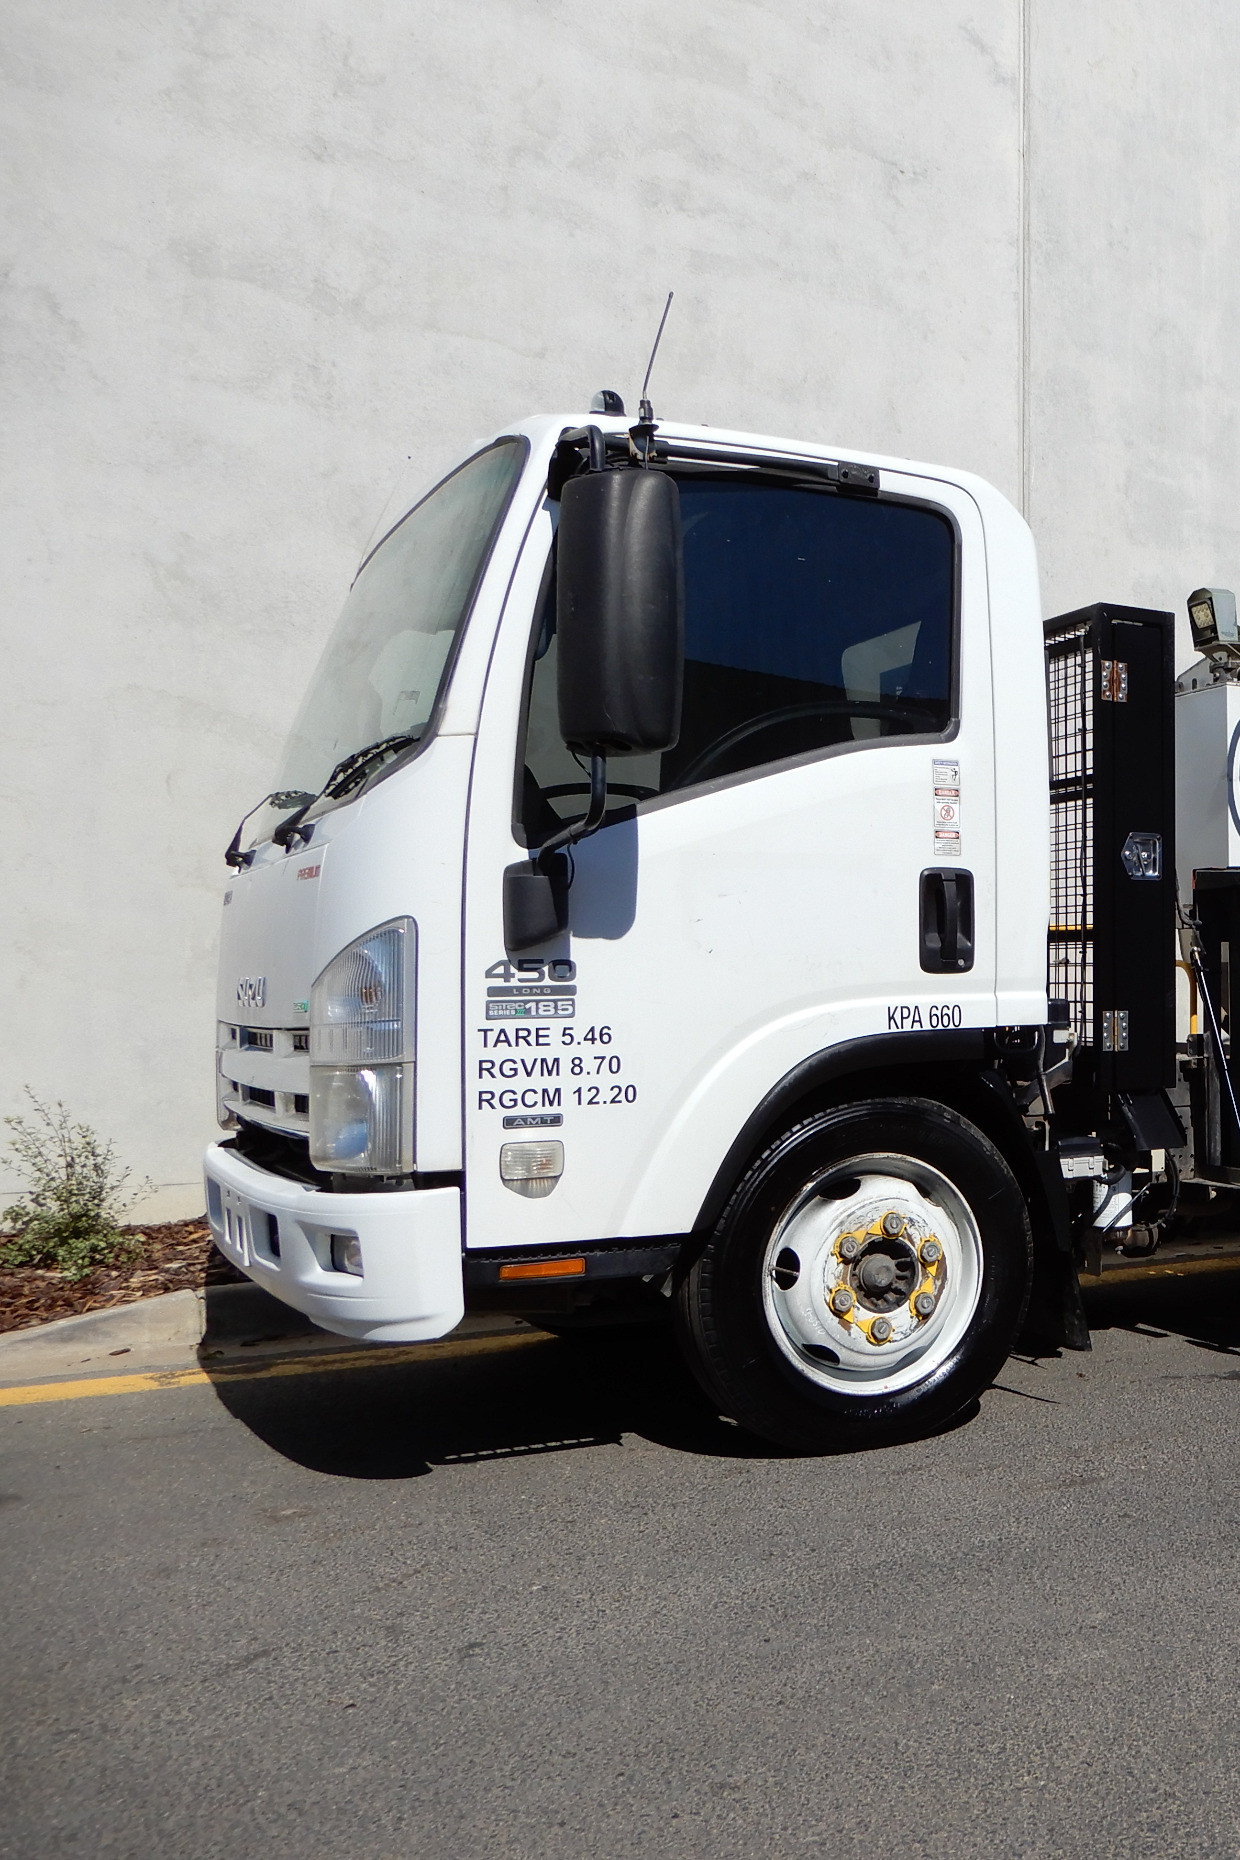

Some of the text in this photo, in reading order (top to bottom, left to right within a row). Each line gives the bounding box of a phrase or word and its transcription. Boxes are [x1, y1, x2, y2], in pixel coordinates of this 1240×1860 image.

[485, 959, 577, 983] 450
[525, 1001, 574, 1016] 185
[887, 1004, 962, 1030] KPA 660
[477, 1026, 612, 1048] TARE 5.46
[478, 1055, 622, 1079] RGVM 8.70
[478, 1084, 638, 1110] RGCM 12.20
[512, 1116, 554, 1126] AMT
